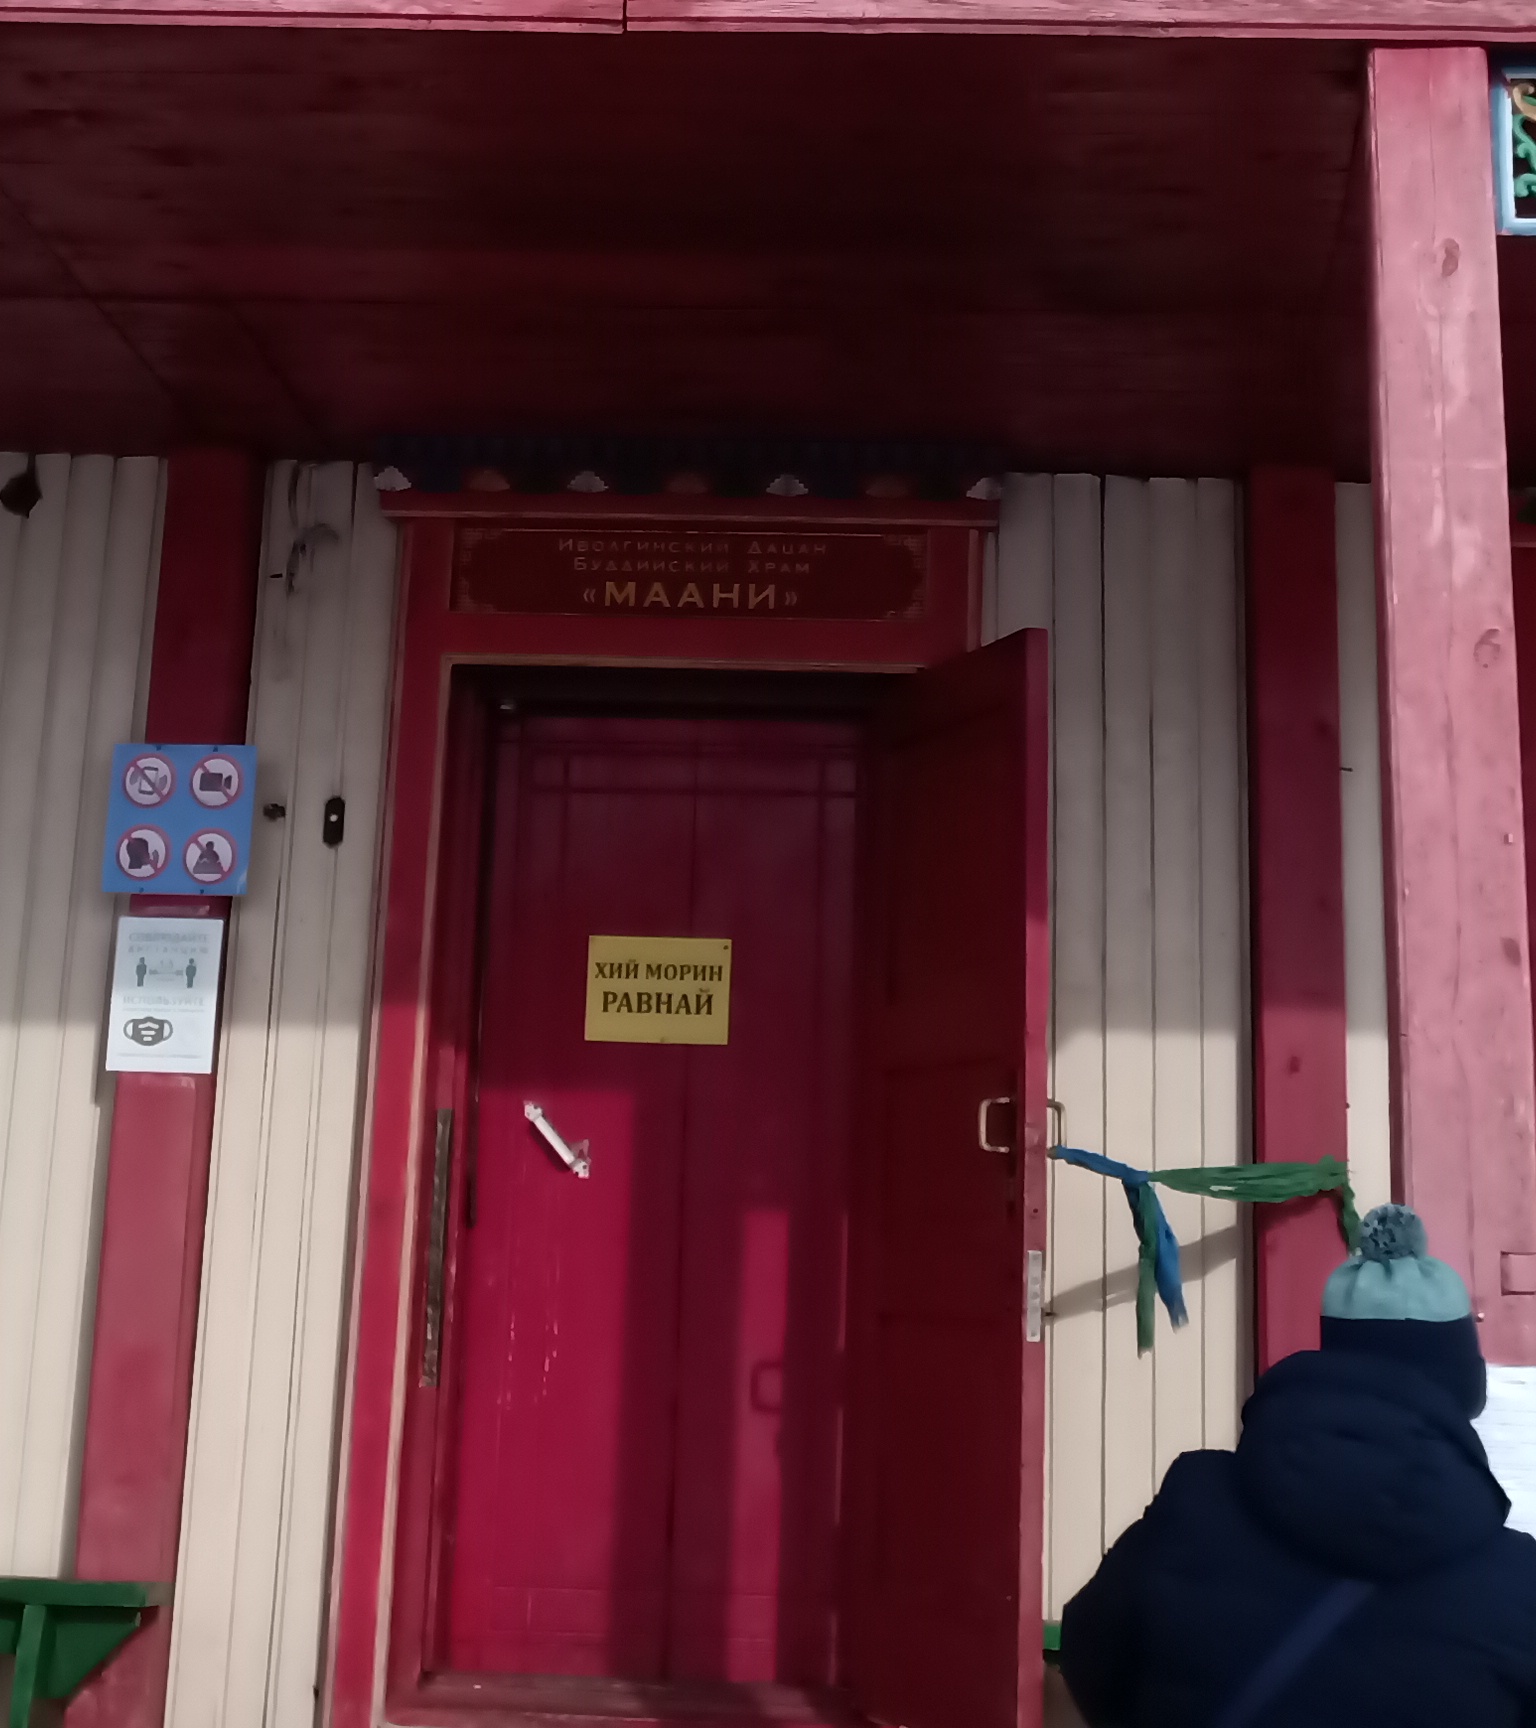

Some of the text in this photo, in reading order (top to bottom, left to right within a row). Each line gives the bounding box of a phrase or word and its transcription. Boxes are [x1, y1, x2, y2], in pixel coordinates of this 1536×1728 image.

[594, 959, 723, 982] ХИЙ МОРИН
[601, 987, 714, 1015] РАВНАЙ
